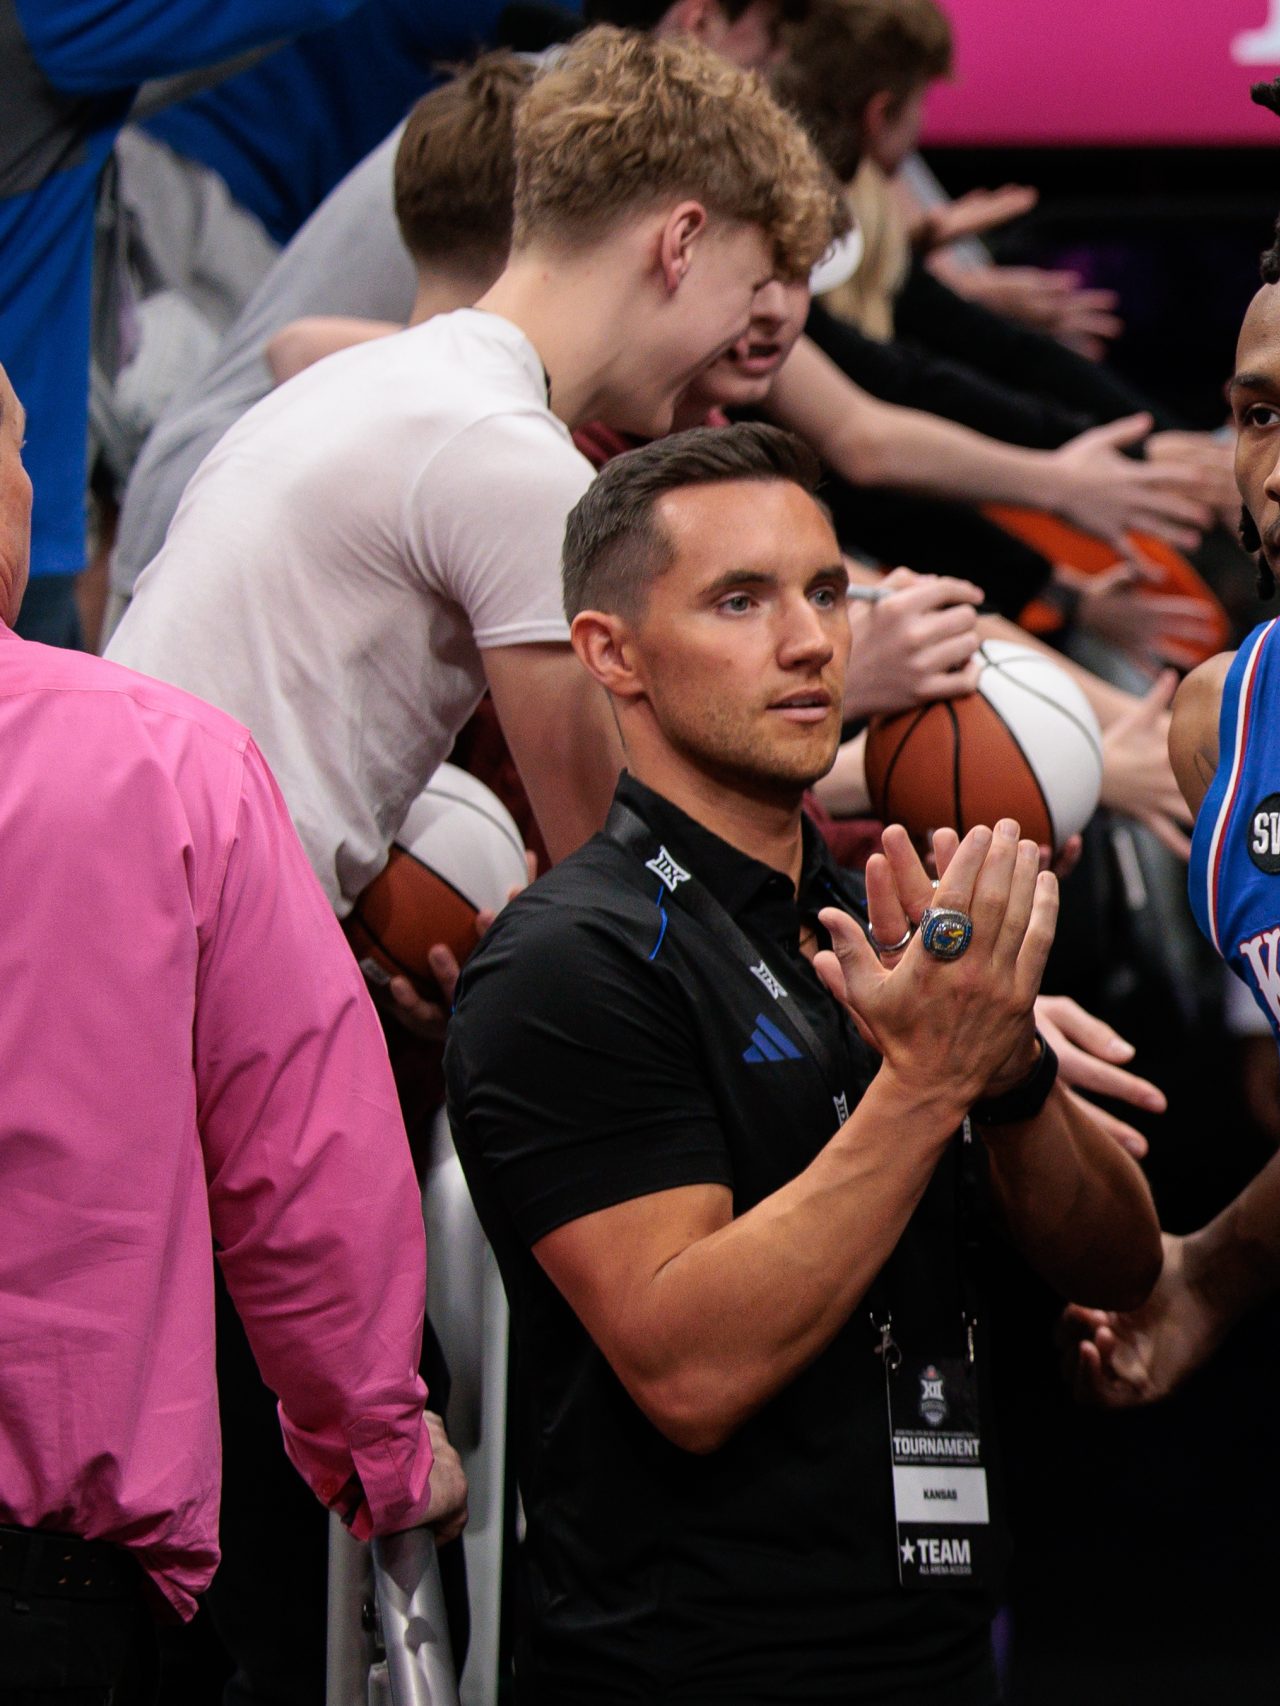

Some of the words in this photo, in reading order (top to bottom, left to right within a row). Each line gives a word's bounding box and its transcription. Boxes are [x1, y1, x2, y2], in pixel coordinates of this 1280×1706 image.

[893, 1436, 980, 1456] TOURNAMENT
[923, 1488, 957, 1500] KANSAS
[916, 1538, 971, 1565] TEAM
